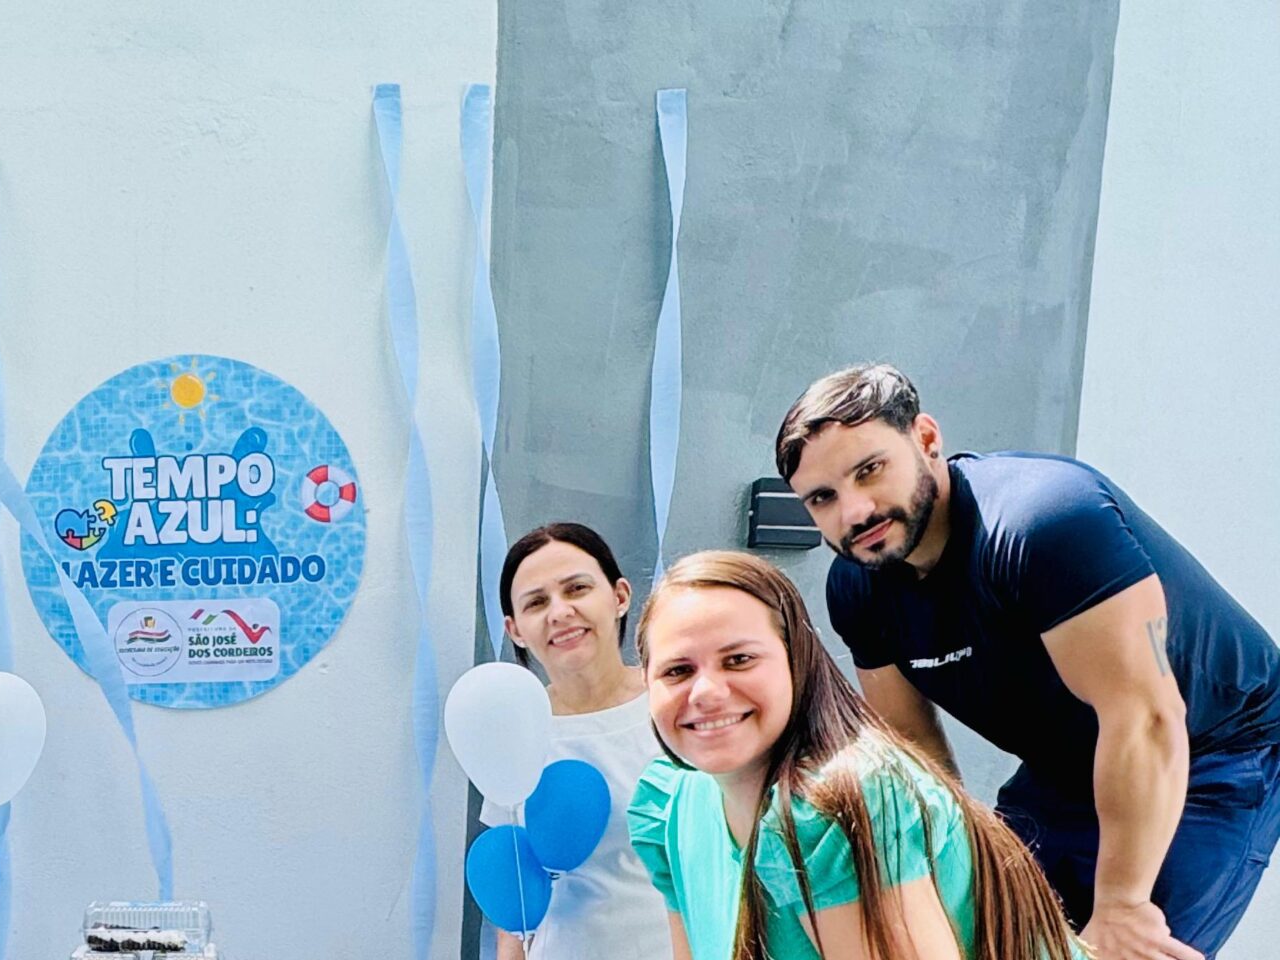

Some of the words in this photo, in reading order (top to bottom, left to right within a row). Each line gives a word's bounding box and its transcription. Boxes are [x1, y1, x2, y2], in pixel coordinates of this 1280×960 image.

[103, 453, 274, 500] TEMPO
[123, 500, 258, 546] AZUL:
[160, 559, 175, 586] E
[182, 554, 326, 586] CUIDADO
[188, 633, 210, 646] SÃO
[212, 631, 237, 647] JOSÉ
[188, 648, 210, 658] DOS
[213, 646, 274, 657] CORDEIROS
